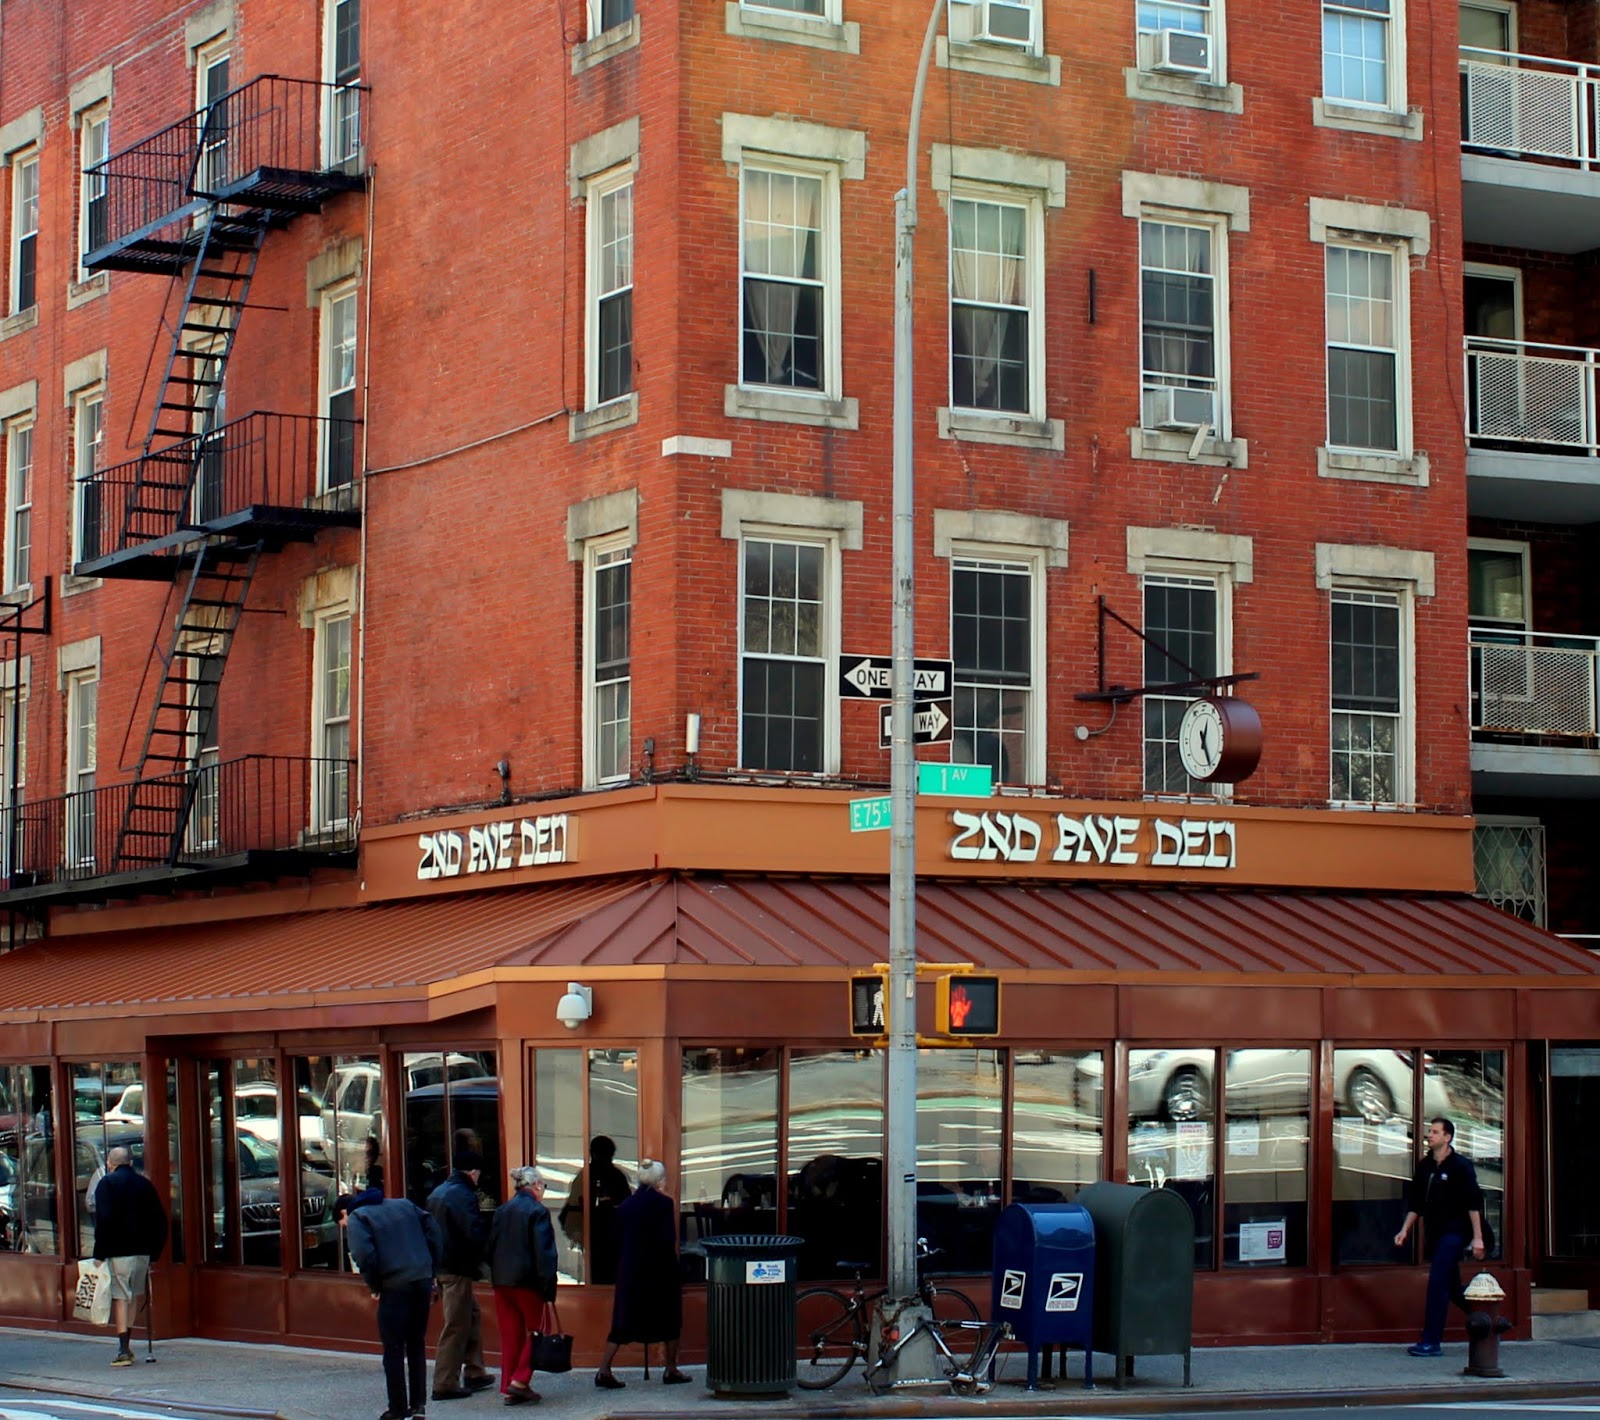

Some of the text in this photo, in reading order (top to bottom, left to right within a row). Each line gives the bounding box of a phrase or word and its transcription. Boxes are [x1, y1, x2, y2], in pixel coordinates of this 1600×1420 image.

[857, 669, 938, 689] ONE AY
[919, 713, 941, 731] WAY
[940, 767, 968, 792] 1 AV
[852, 804, 862, 828] E
[863, 802, 882, 827] 75
[417, 813, 568, 880] 2ND AVE DELI
[950, 809, 1237, 868] 2ND AVE DELI
